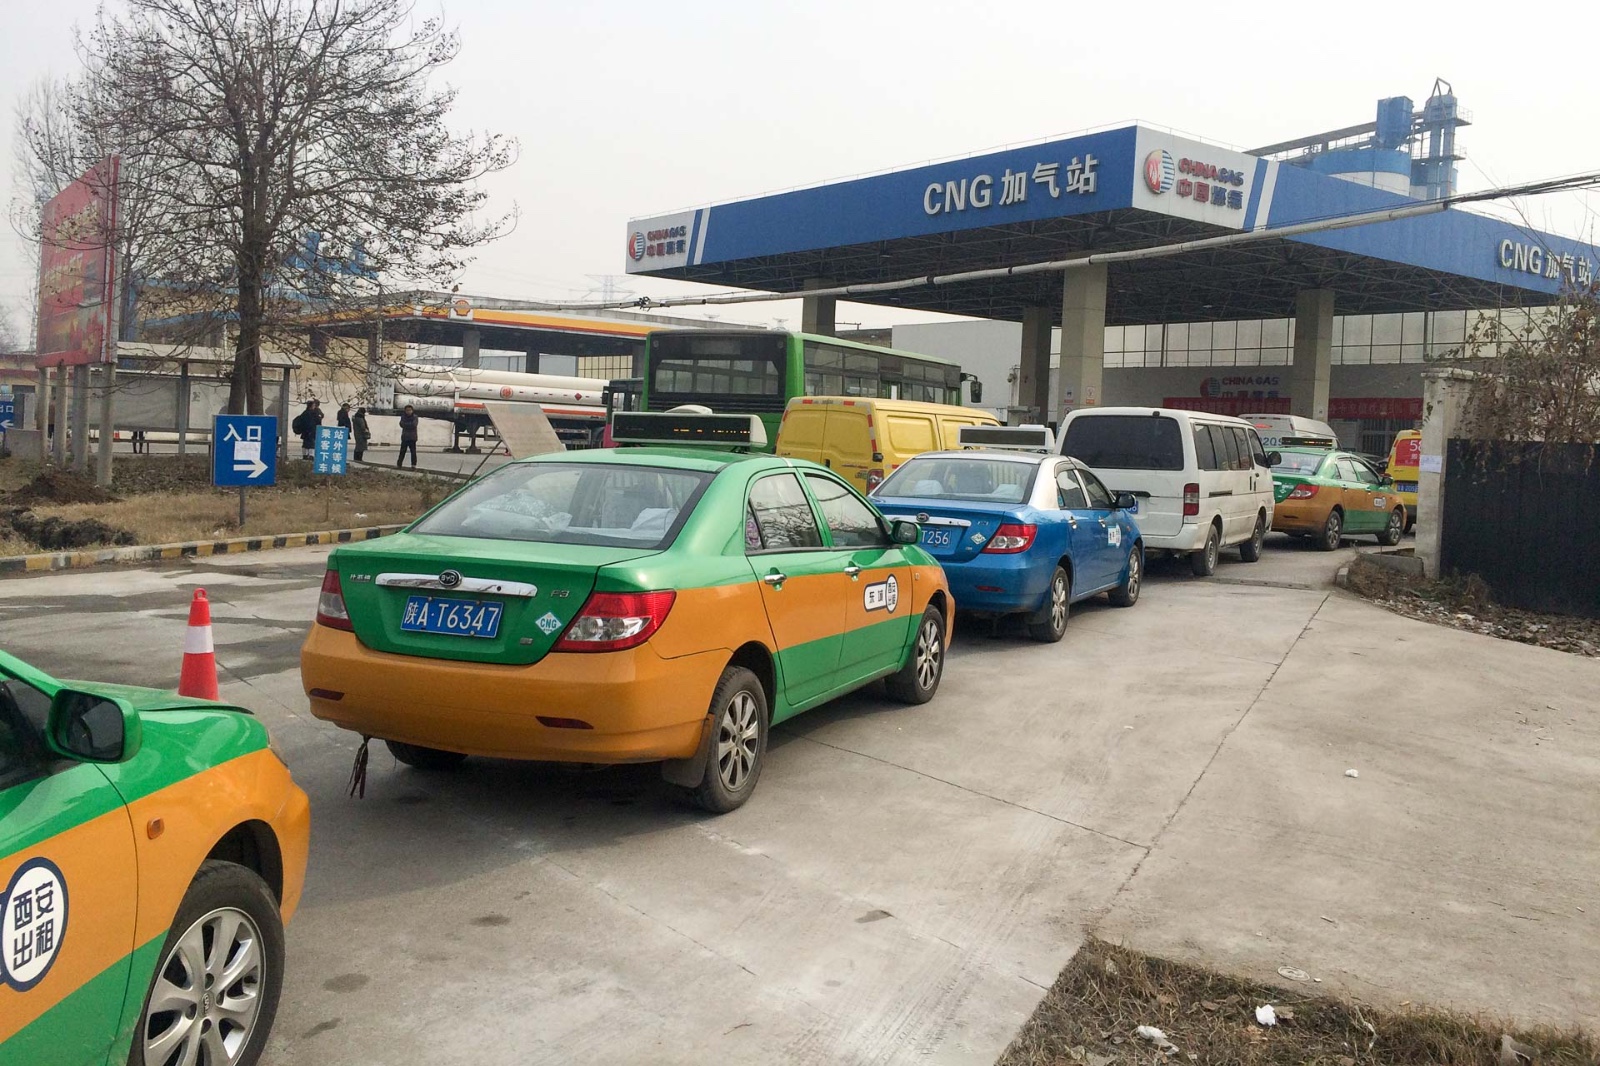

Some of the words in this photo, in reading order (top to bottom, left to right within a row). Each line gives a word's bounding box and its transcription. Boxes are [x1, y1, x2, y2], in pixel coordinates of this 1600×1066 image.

[923, 173, 994, 215] CNG
[999, 153, 1098, 206] 加气站
[1178, 158, 1218, 181] CHINA
[1499, 239, 1542, 274] CNG
[223, 423, 262, 441] 入口
[403, 601, 499, 632] 陕A·T6347
[540, 618, 557, 629] CNG
[13, 880, 54, 932] 西安
[13, 918, 54, 971] 出租
